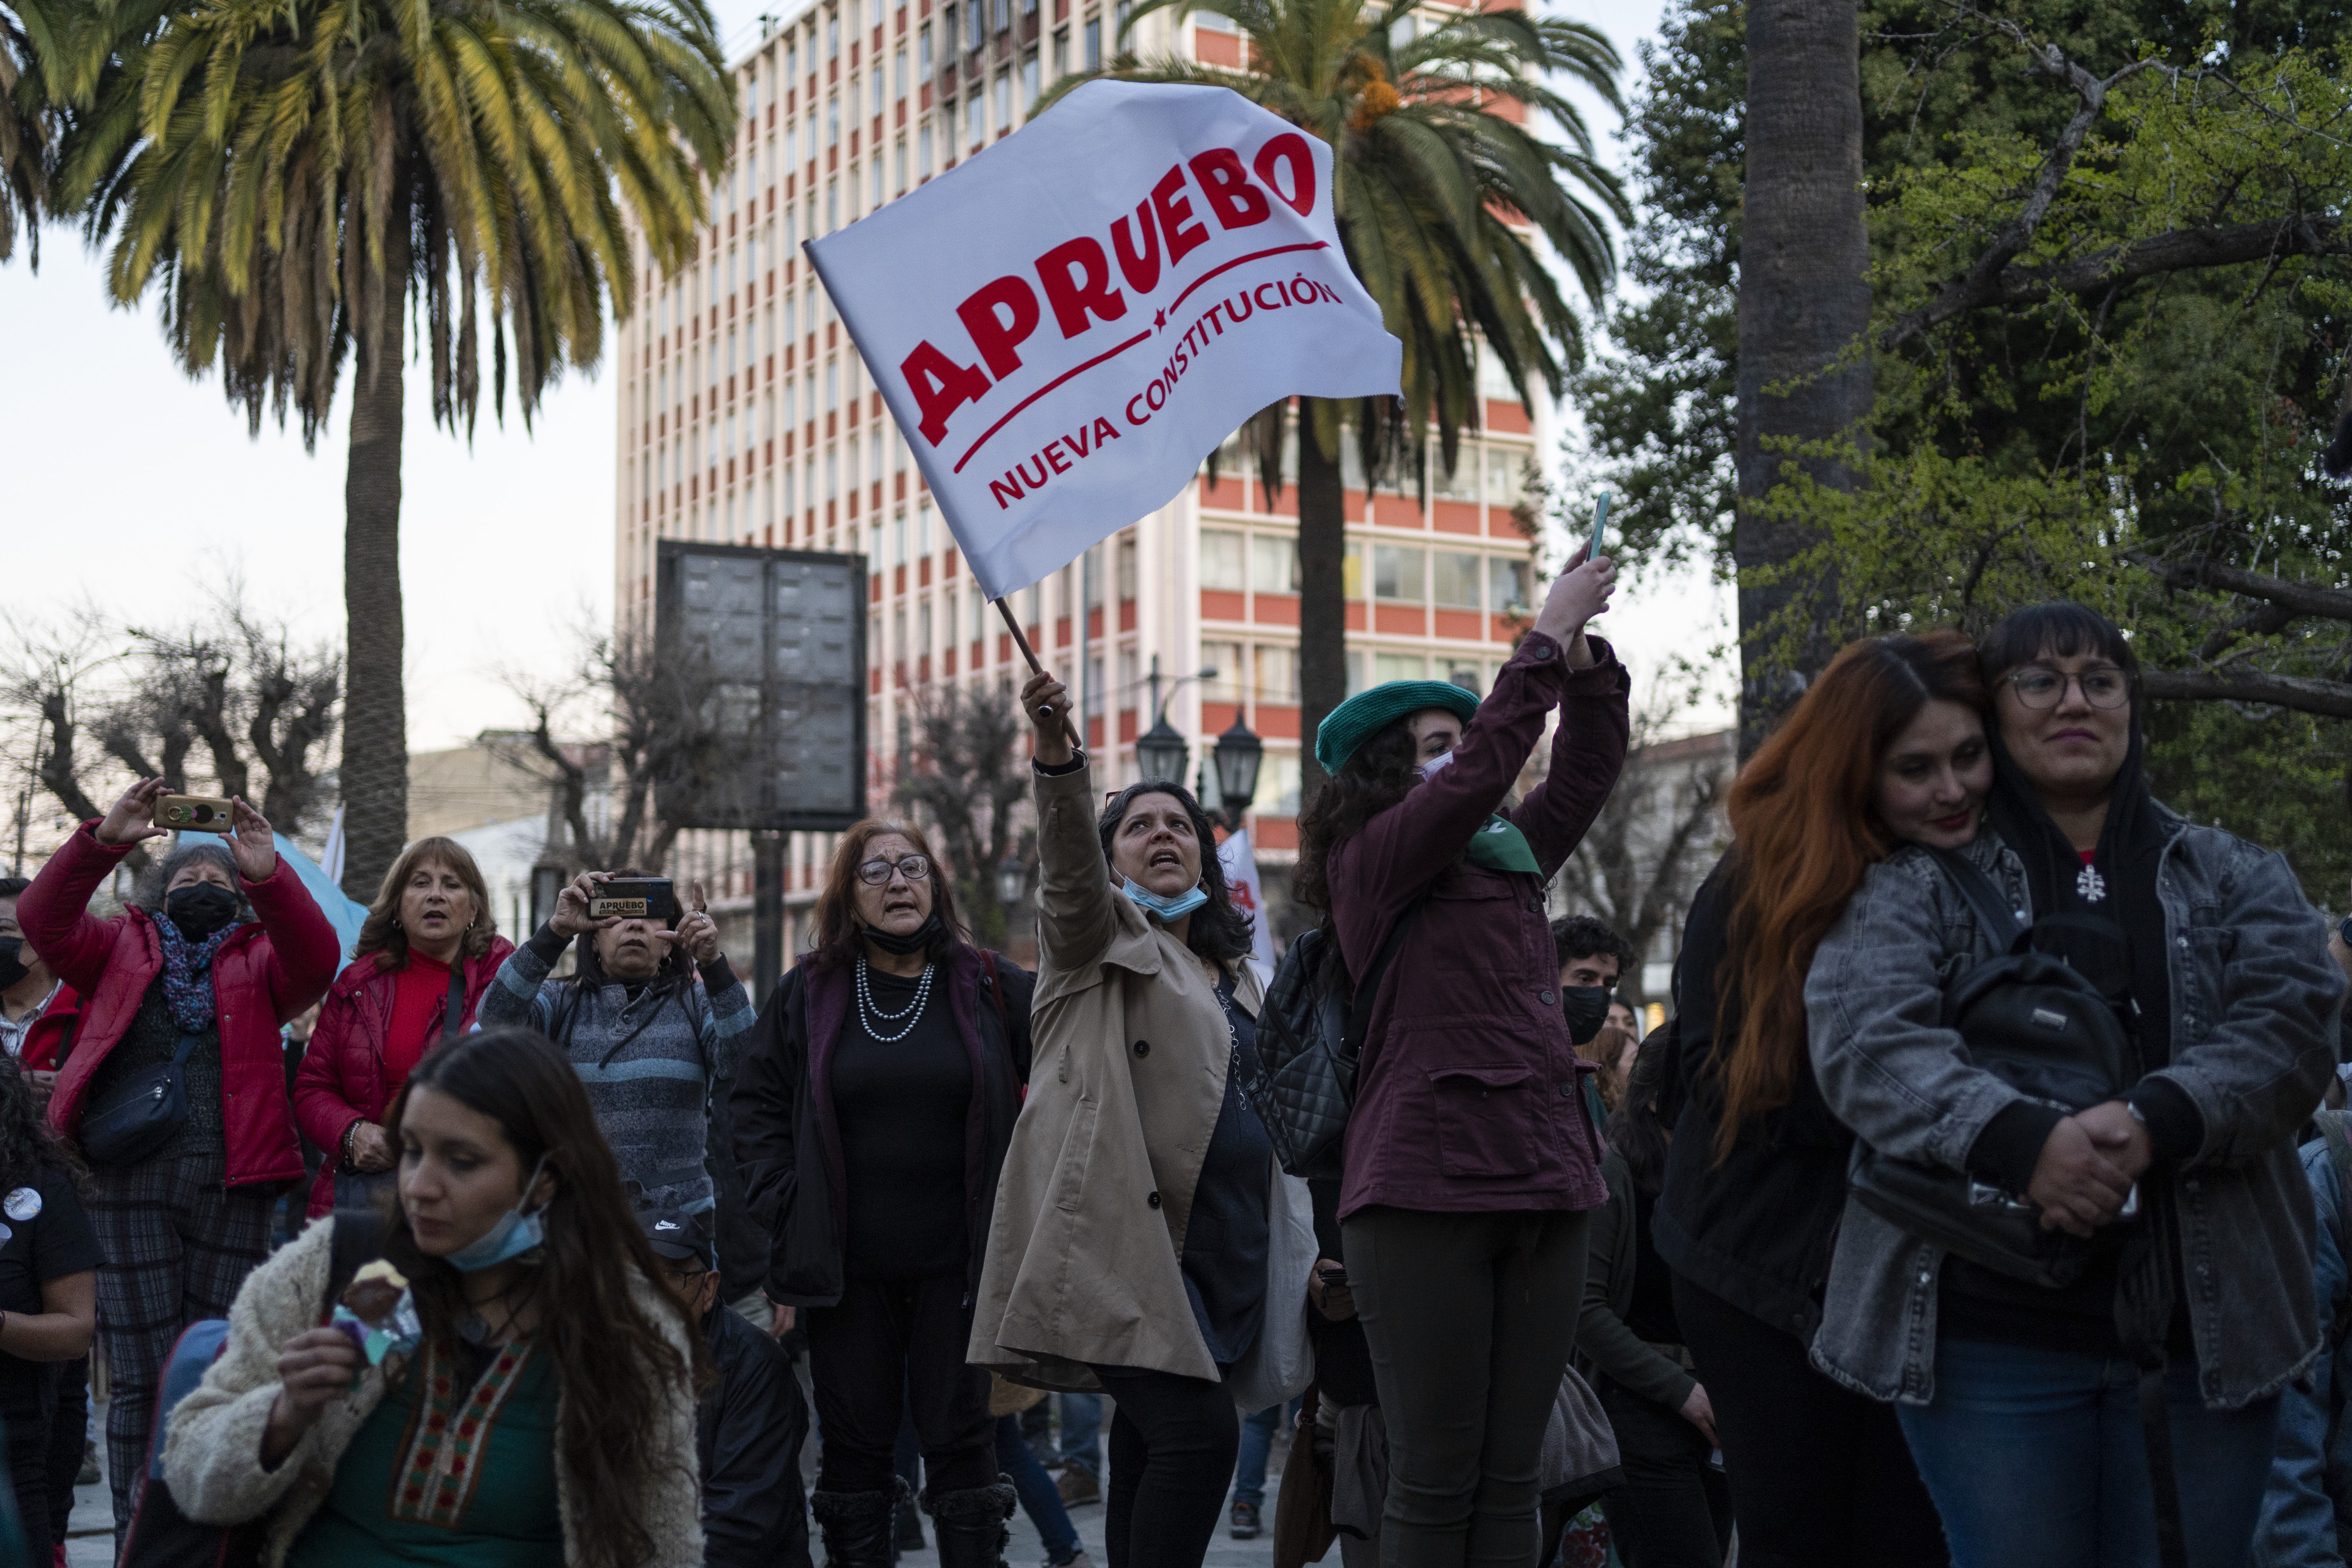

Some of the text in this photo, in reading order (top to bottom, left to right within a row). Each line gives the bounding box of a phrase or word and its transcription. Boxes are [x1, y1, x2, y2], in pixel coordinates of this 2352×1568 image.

[901, 133, 1316, 448] APRUEBO
[989, 271, 1343, 510] NUEVA CONSTITUCIÓN
[600, 901, 644, 911] APRUEBO
